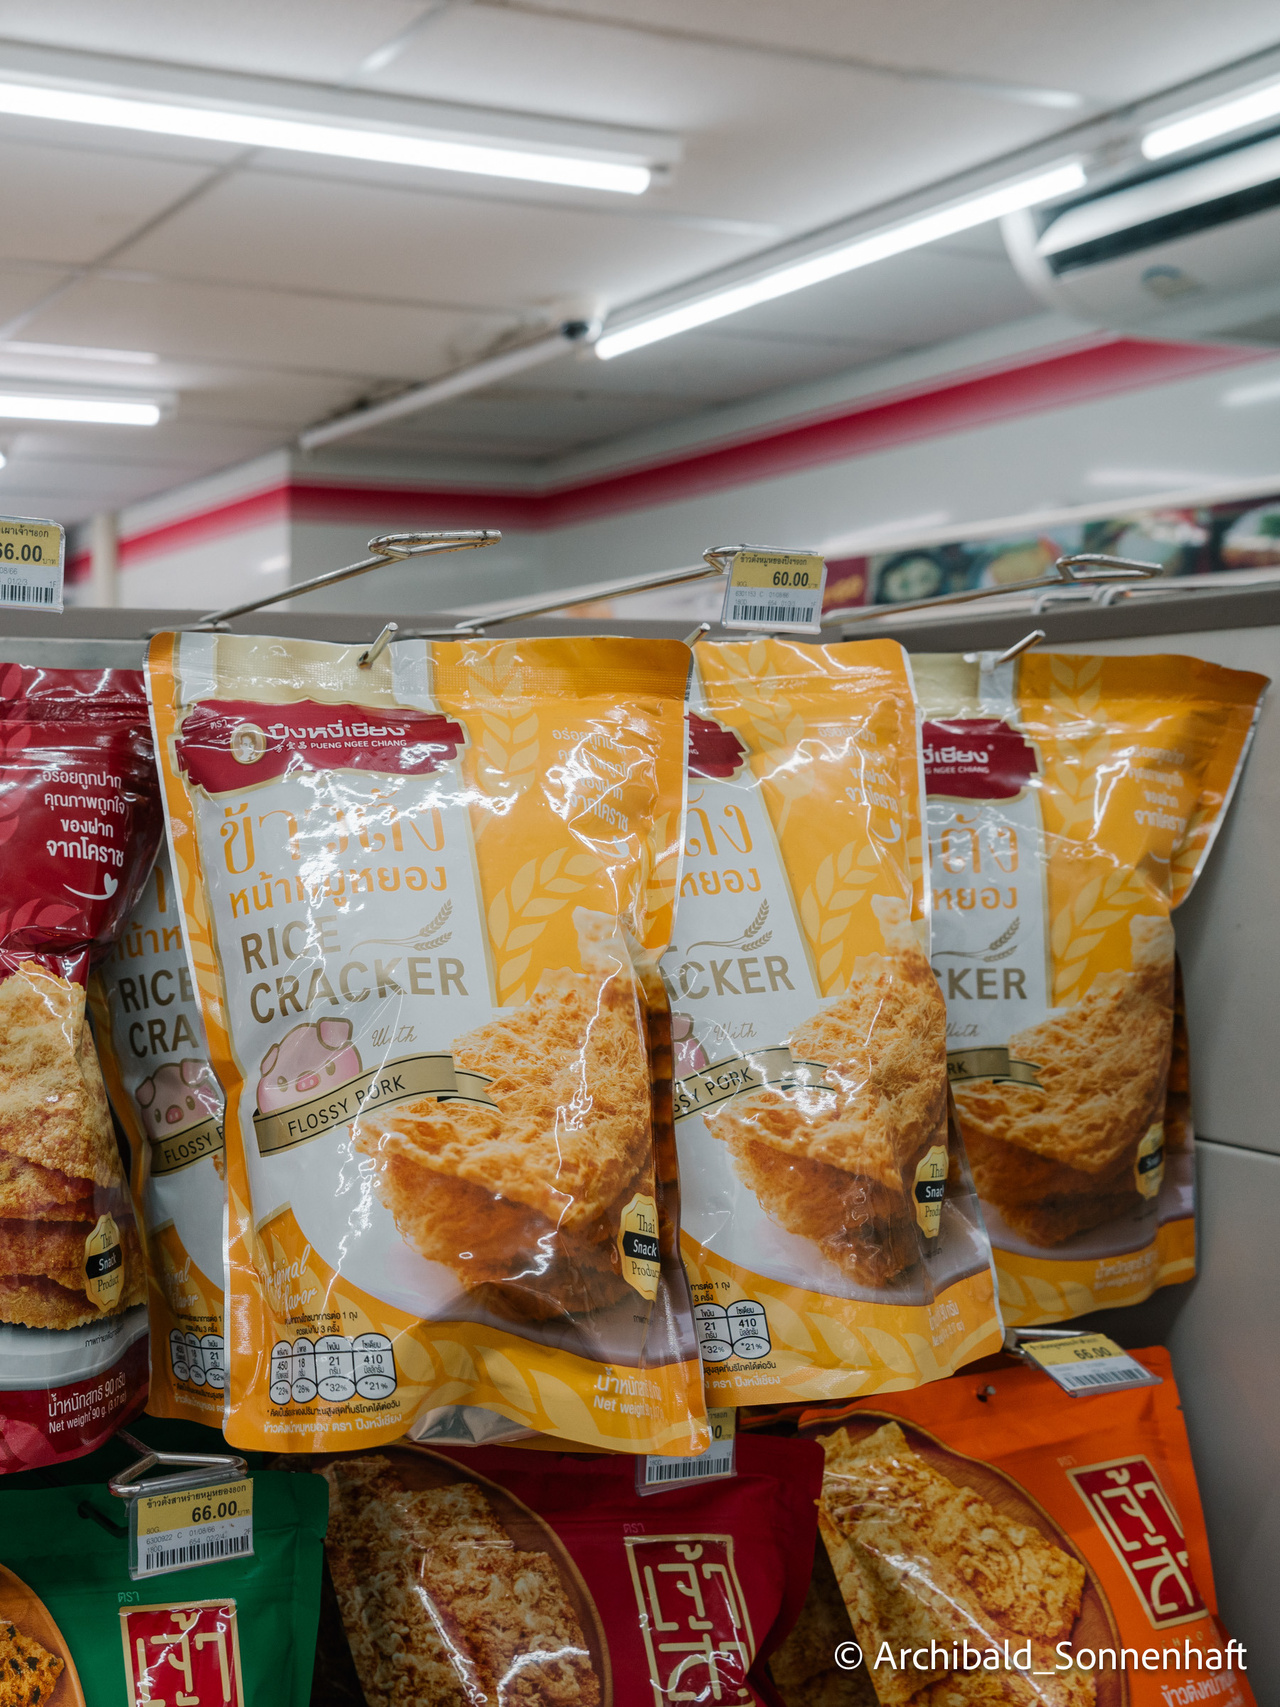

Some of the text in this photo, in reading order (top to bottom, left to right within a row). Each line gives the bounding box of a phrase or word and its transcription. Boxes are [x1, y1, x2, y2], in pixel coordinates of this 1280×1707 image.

[773, 571, 809, 587] 60.00
[311, 739, 407, 750] PUENG NGEE CHIANG
[44, 793, 125, 816] คุณภาพถูกใจ
[60, 817, 114, 838] ของฝาก
[46, 836, 124, 868] จากโคราช
[241, 915, 341, 974] RICE
[250, 956, 469, 1024] CRACKER
[372, 1024, 418, 1048] With
[704, 1067, 755, 1094] PORK
[288, 1074, 406, 1137] FLOSSY PORK
[164, 1131, 213, 1165] FLOSSY
[636, 1213, 655, 1234] Thai
[633, 1239, 657, 1257] Snack
[98, 1251, 118, 1272] Snack
[715, 1281, 719, 1289] 1
[694, 1294, 699, 1302] 3
[342, 1311, 346, 1320] 1
[738, 1318, 757, 1328] 410
[321, 1325, 326, 1334] 3
[704, 1322, 716, 1331] 21
[210, 1352, 219, 1361] 21
[328, 1356, 340, 1366] 21
[364, 1354, 383, 1365] 410
[1073, 1346, 1113, 1360] 66.00
[277, 1361, 289, 1371] 450
[298, 1358, 305, 1368] 18
[105, 1378, 115, 1397] 90
[713, 1379, 732, 1389] ตรา
[593, 1395, 617, 1412] Net
[48, 1421, 65, 1434] Net
[66, 1411, 91, 1430] weight
[92, 1406, 100, 1420] 90
[332, 1421, 353, 1433] ตรา
[192, 1500, 238, 1523] 66.00
[146, 1534, 173, 1545] 6300922
[189, 1526, 216, 1537] 01/08/66
[623, 1522, 645, 1534] ตรา
[117, 1591, 140, 1603] ตรา
